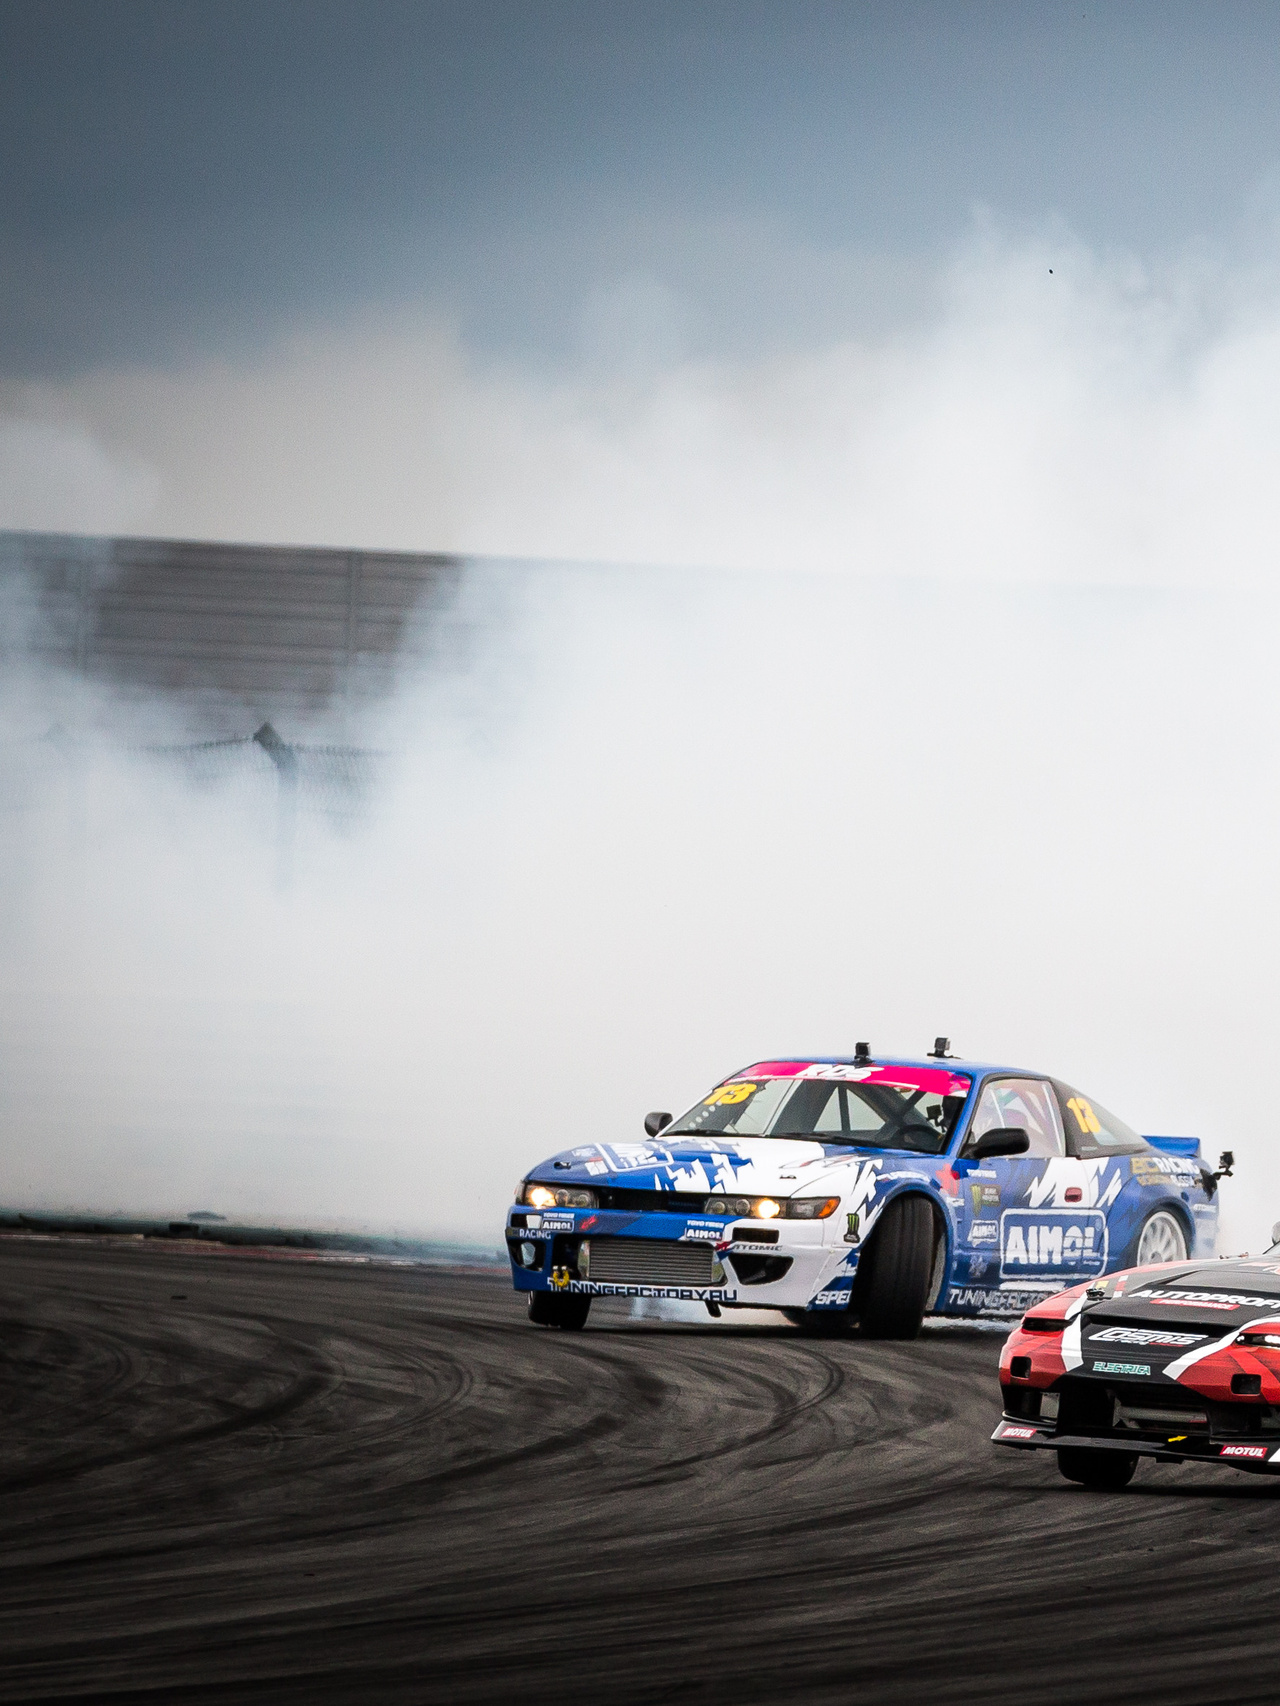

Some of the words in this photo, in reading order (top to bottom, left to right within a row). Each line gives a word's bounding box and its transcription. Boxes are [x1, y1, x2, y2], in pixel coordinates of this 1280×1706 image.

[704, 1084, 757, 1105] 13
[1066, 1098, 1101, 1133] 13
[543, 1221, 571, 1230] AIMOL
[519, 1229, 552, 1239] RACING
[687, 1229, 722, 1239] AIMOL
[1006, 1225, 1100, 1265] AIMOL
[1092, 1361, 1151, 1376] ELECTRICA
[1002, 1427, 1034, 1438] MOTUL
[1222, 1446, 1264, 1458] MOTUL
